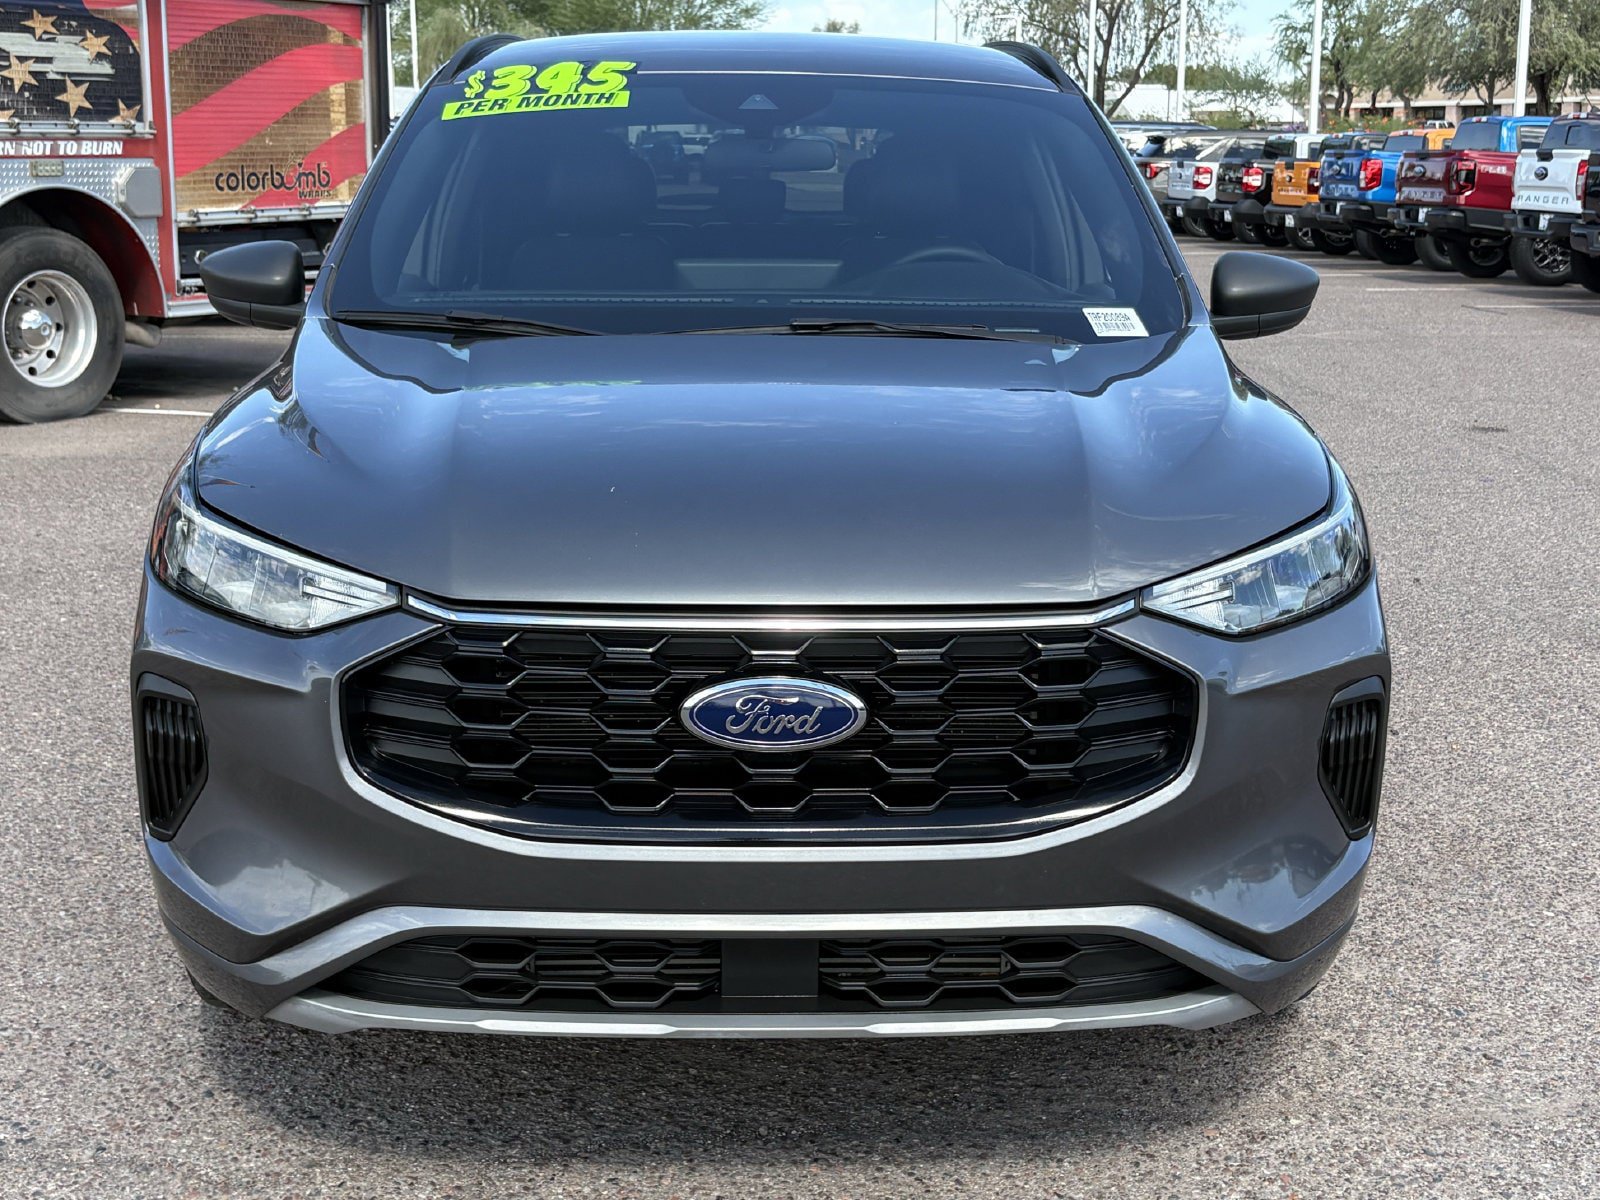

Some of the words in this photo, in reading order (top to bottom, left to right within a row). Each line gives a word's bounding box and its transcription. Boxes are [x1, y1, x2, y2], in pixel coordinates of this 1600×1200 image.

[464, 61, 636, 100] $345
[454, 98, 508, 115] PER
[516, 92, 618, 109] MONTH
[21, 141, 54, 155] NOT
[57, 141, 78, 155] TO
[81, 141, 123, 155] BURN
[1517, 194, 1569, 205] RANGER
[725, 694, 824, 735] Ford
